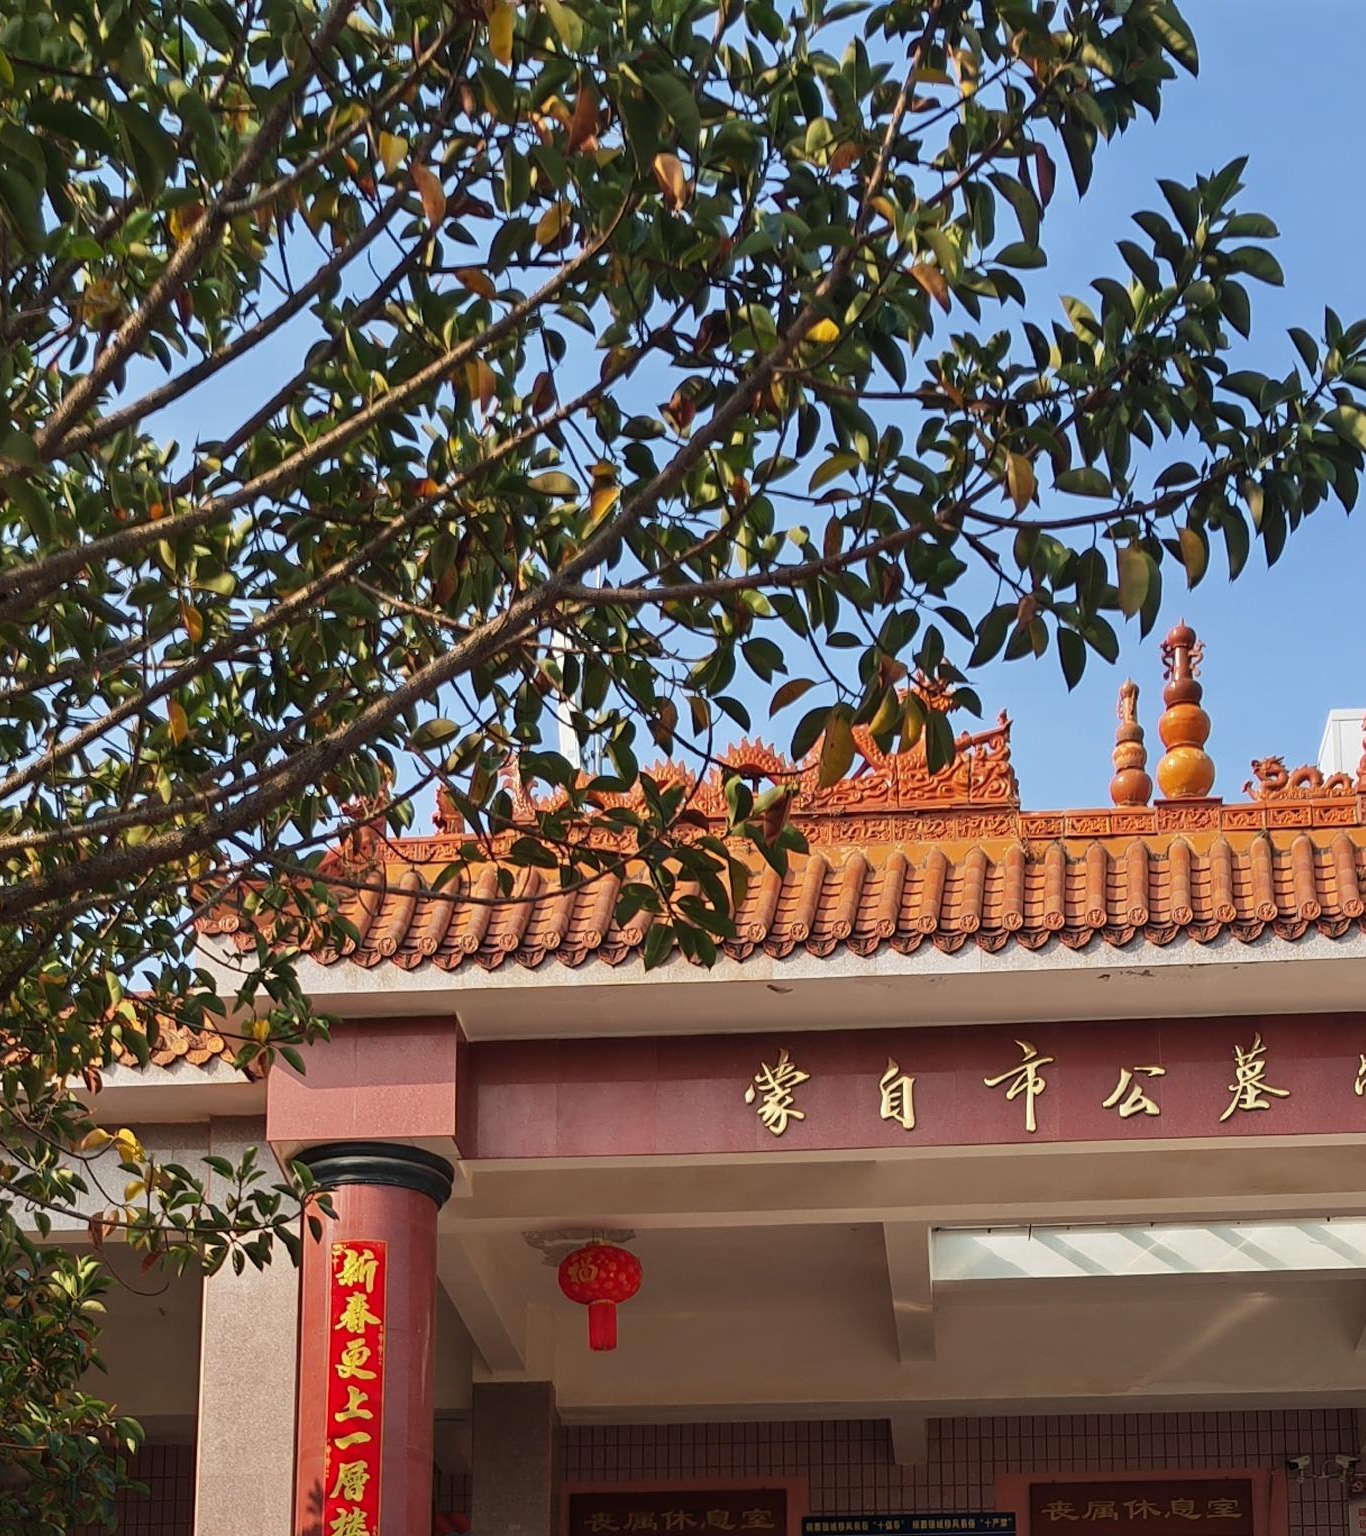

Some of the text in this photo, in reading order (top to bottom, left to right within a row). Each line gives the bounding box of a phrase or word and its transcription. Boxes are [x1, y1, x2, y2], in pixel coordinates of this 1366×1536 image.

[584, 1508, 775, 1533] 丧属休息室
[1041, 1497, 1244, 1521] 丧属休息室
